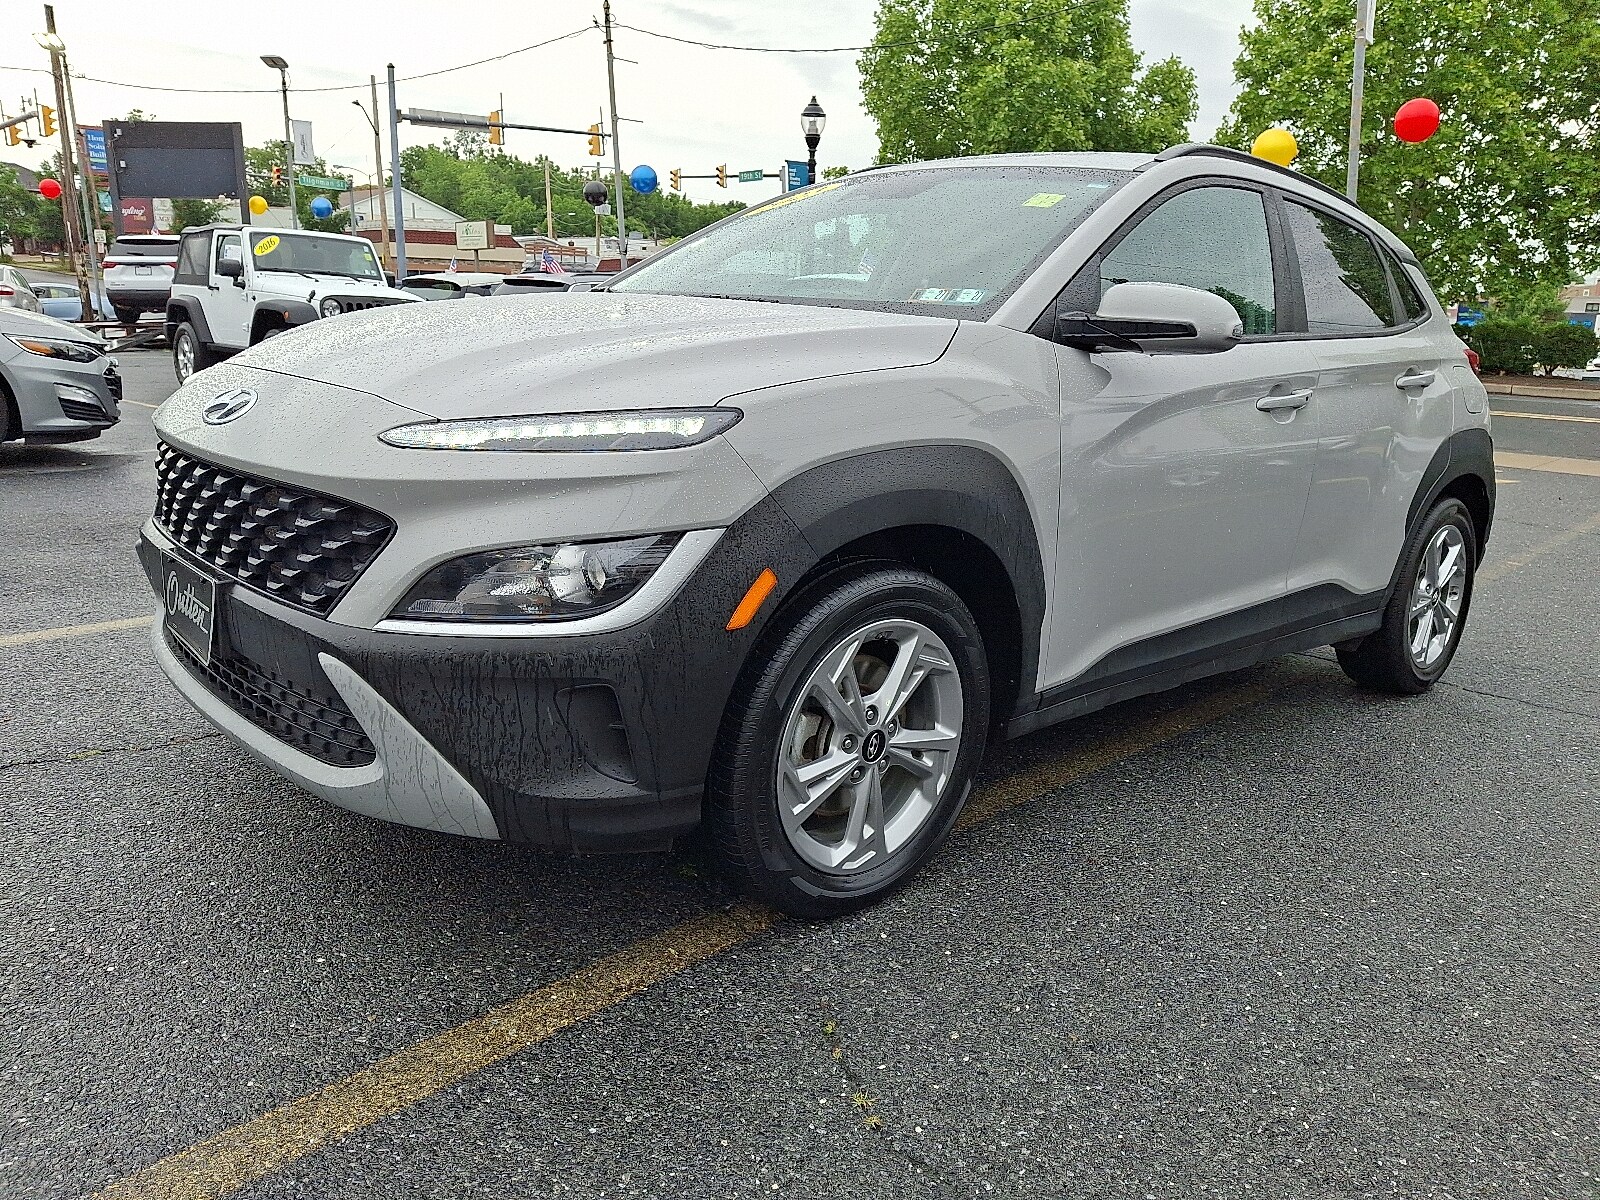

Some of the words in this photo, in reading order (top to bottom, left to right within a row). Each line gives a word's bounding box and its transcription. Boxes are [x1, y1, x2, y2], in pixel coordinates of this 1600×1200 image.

[301, 176, 335, 186] Tilghman
[258, 239, 275, 255] 2016
[167, 571, 209, 633] Outten
